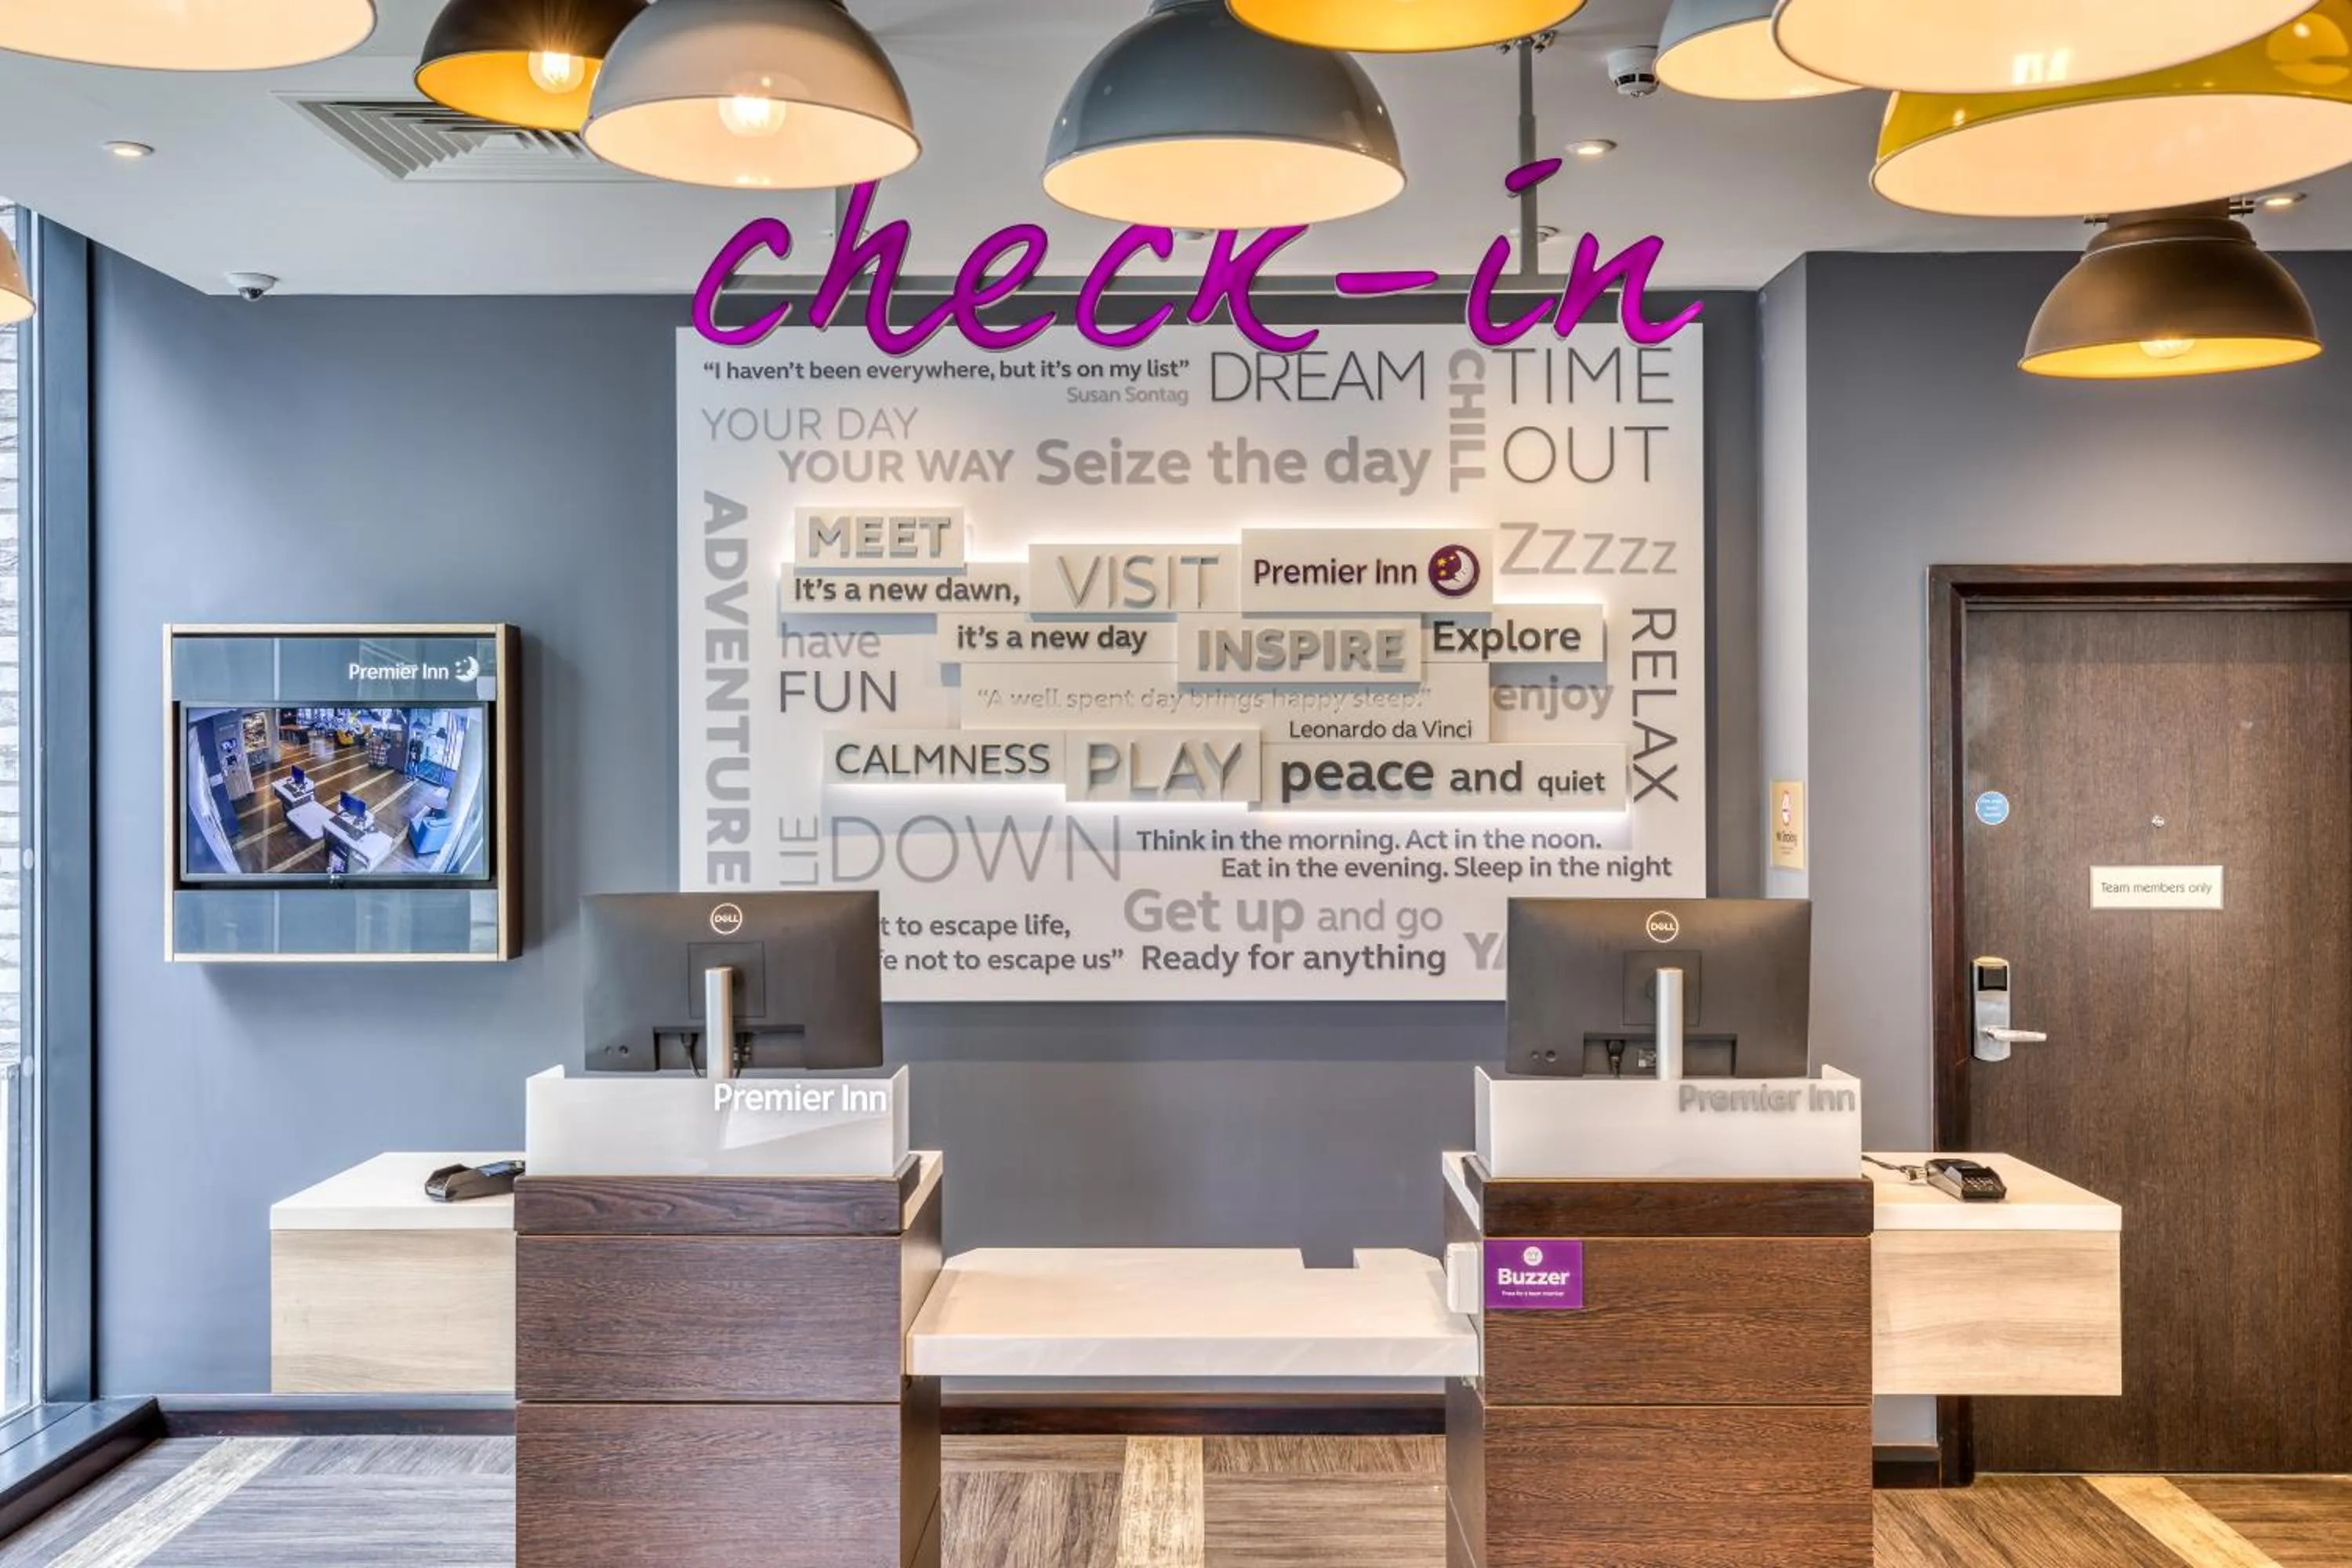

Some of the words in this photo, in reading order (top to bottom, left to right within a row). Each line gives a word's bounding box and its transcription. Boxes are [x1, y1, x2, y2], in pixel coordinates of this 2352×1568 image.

[691, 156, 1704, 357] check-in
[727, 361, 804, 379] haven’t
[810, 361, 861, 379] been
[866, 361, 994, 383] everywhere,
[1000, 360, 1034, 379] but
[1040, 360, 1071, 378] it’s
[1076, 365, 1103, 378] on
[1109, 365, 1142, 383] my
[1147, 359, 1189, 378] list”
[1210, 350, 1425, 402] DREAM
[1491, 347, 1674, 404] TIME
[1067, 387, 1120, 404] Susan
[1125, 386, 1189, 407] Sontag
[702, 407, 822, 441] YOUR
[838, 406, 919, 440] DAY
[1448, 348, 1486, 493] CHILL
[779, 449, 904, 483] YOUR
[916, 448, 1014, 482] WAY
[1036, 437, 1190, 485] Seize
[1207, 436, 1307, 484] the
[1325, 435, 1432, 496] day
[1503, 426, 1669, 483] OUT
[808, 515, 951, 558] MEET
[1058, 555, 1219, 608] VISIT
[1253, 558, 1367, 585] Premier
[1375, 558, 1417, 585] Inn
[795, 578, 837, 601] It’s
[844, 584, 861, 602] a
[869, 584, 927, 602] new
[935, 577, 1020, 606] dawn,
[781, 623, 881, 659] have
[957, 625, 998, 649] it’s
[1005, 631, 1023, 649] a
[1030, 630, 1089, 649] new
[1097, 624, 1148, 655] day
[1197, 630, 1406, 672] INSPIRE
[1433, 620, 1581, 658] Explore
[349, 662, 418, 681] Premier
[423, 662, 449, 681] Inn
[703, 490, 751, 884] ADVENTURE
[780, 671, 898, 713] FUN
[1011, 688, 1060, 707] well
[1066, 688, 1134, 711] spent
[1141, 688, 1183, 711] day
[1191, 688, 1265, 712] brings
[1271, 688, 1348, 713] happy
[1493, 676, 1614, 719] enjoy
[1632, 608, 1678, 802] RELAX
[1289, 720, 1386, 739] Leonardo
[1392, 720, 1417, 739] da
[1422, 720, 1473, 739] Vinci
[835, 743, 1051, 775] CALMNESS
[1086, 740, 1243, 800] PLAY
[1281, 758, 1433, 803] peace
[1450, 760, 1523, 793] and
[1537, 771, 1606, 797] quiet
[779, 814, 818, 886] LIE
[830, 814, 1120, 883] DOWN
[1137, 829, 1205, 851] Think
[1211, 829, 1232, 851] in
[1240, 829, 1281, 851] the
[1288, 829, 1400, 855] morning.
[1405, 829, 1448, 850] Act
[1454, 829, 1477, 850] in
[1483, 828, 1526, 850] the
[1532, 833, 1602, 850] noon.
[1221, 857, 1261, 878] Eat
[1269, 857, 1290, 877] in
[1296, 855, 1338, 877] the
[1344, 856, 1449, 882] evening.
[1454, 855, 1523, 882] Sleep
[1530, 855, 1551, 877] in
[1556, 855, 1599, 877] the
[1606, 855, 1672, 881] night
[2100, 882, 2130, 893] Team
[2133, 882, 2185, 893] members
[2188, 882, 2213, 895] only
[714, 914, 739, 923] DELL
[897, 918, 923, 936] to
[929, 920, 1018, 942] escape
[1024, 913, 1071, 940] life,
[1124, 888, 1214, 933] Get
[1236, 898, 1304, 942] up
[1317, 899, 1389, 932] and
[1396, 904, 1443, 937] go
[1650, 922, 1675, 931] DELL
[905, 952, 947, 970] not
[953, 952, 980, 970] to
[987, 953, 1076, 975] escape
[1082, 949, 1124, 970] us”
[1142, 945, 1240, 976] Ready
[1247, 944, 1294, 970] for
[1303, 944, 1446, 976] anything
[714, 1083, 834, 1112] Premier
[841, 1083, 887, 1112] Inn
[1679, 1083, 1802, 1112] Premier
[1809, 1083, 1855, 1112] Inn
[1497, 1268, 1570, 1285] Buzzer
